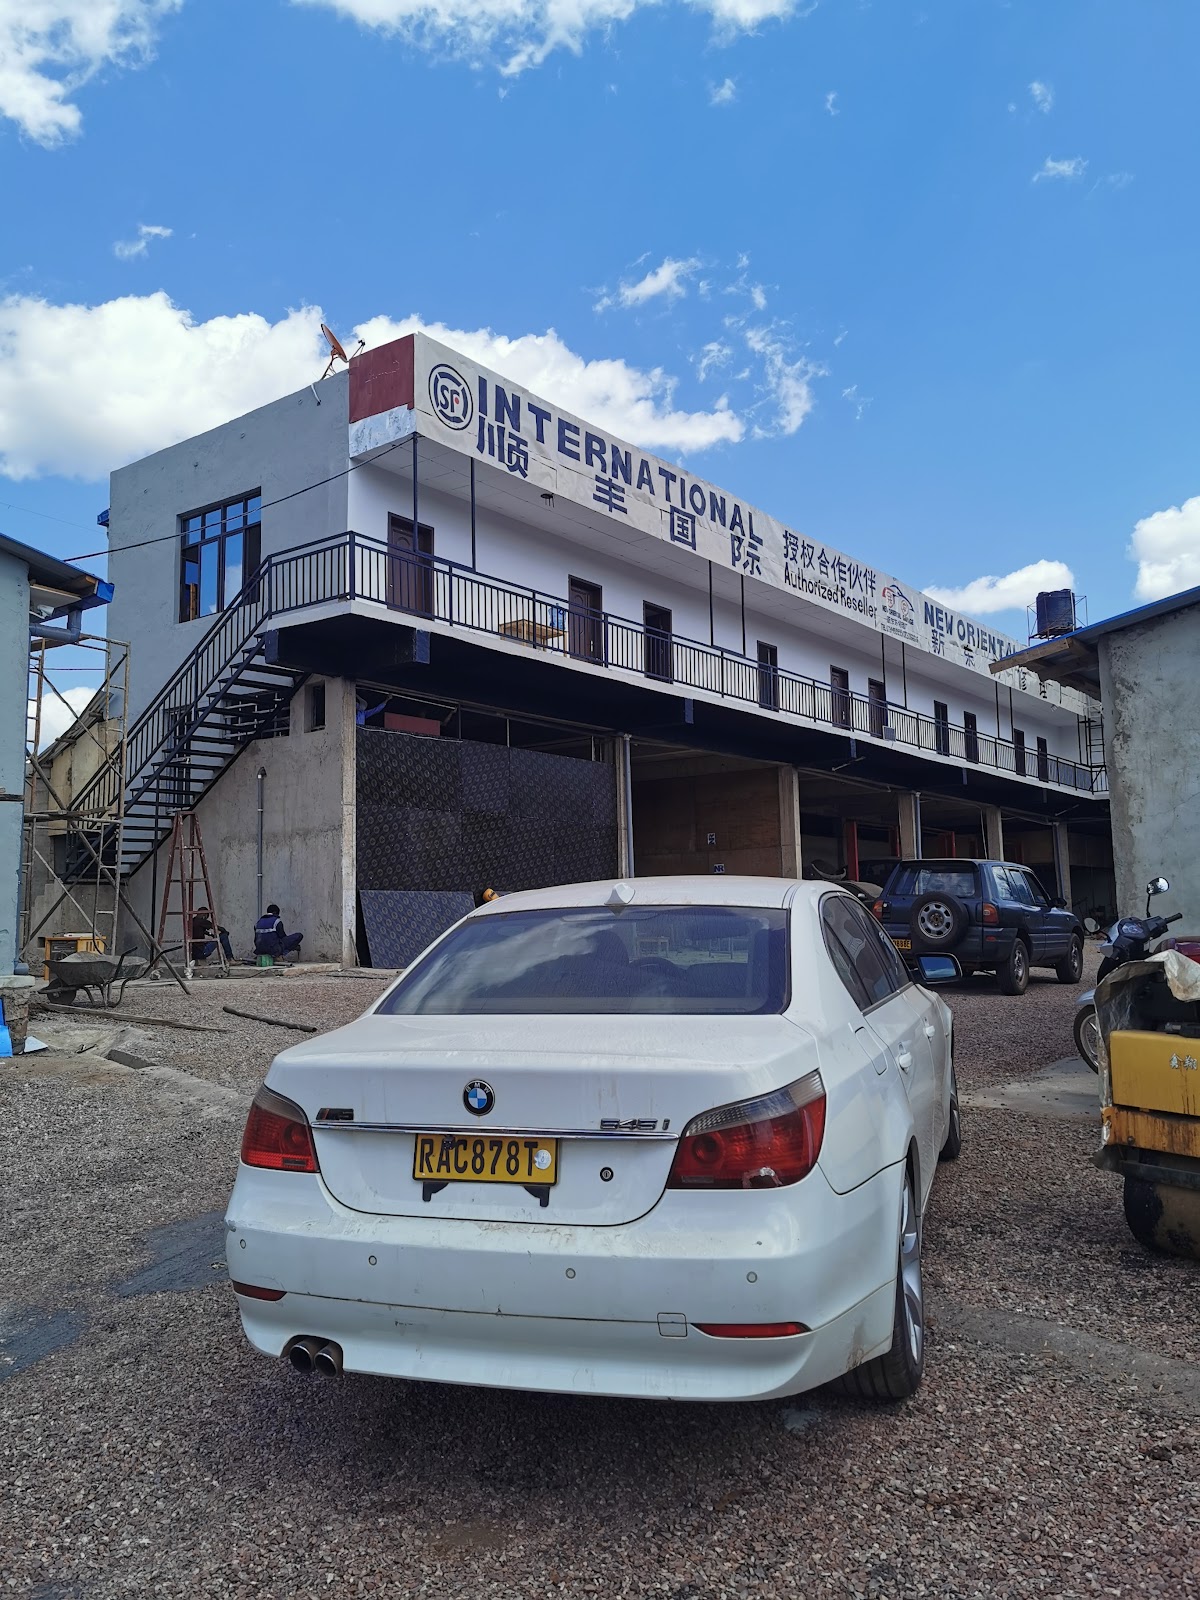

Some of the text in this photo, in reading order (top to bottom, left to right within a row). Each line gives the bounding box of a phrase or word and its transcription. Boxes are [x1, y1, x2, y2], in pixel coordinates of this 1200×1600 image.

[478, 375, 763, 546] INTERNATIONAL
[782, 529, 877, 598] 授权合作伙伴
[784, 561, 839, 604] Authorized
[840, 586, 877, 619] Reseller
[924, 601, 954, 636] NEW
[419, 1138, 539, 1176] RAC878T
